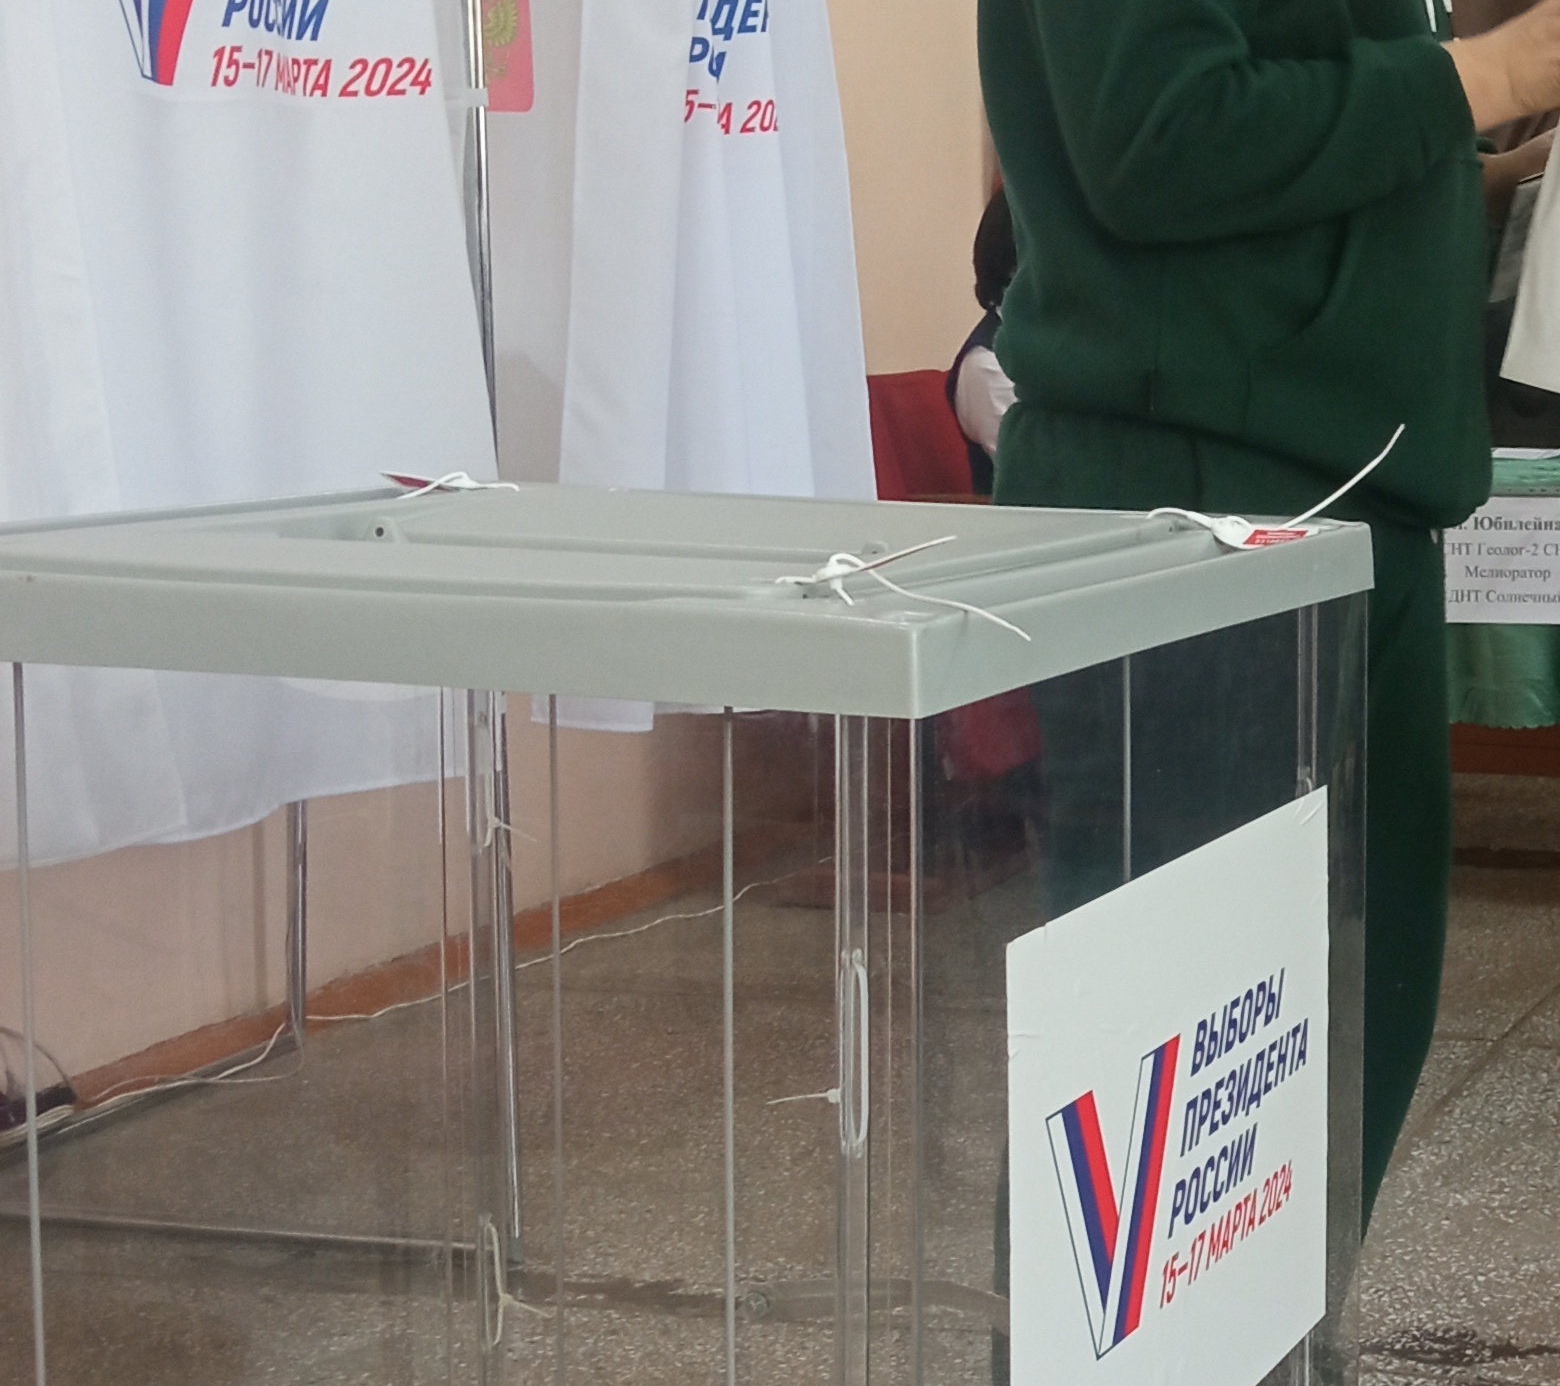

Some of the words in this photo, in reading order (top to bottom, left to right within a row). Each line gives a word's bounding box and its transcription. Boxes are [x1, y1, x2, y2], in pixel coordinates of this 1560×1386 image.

[211, 45, 274, 88] 15-17
[275, 48, 333, 98] МАРТА
[338, 56, 433, 98] 2024
[1448, 589, 1483, 604] ДНТ
[1464, 565, 1552, 582] Мелиоратор
[1190, 967, 1285, 1078] ВЫБОРЫ
[1179, 1017, 1309, 1158] ПРЕЗИДЕНТА
[1159, 1229, 1207, 1310] 15-17
[1205, 1187, 1258, 1271] МАРТА
[1258, 1159, 1293, 1227] 2024
[1167, 1121, 1258, 1240] РОССИИ
